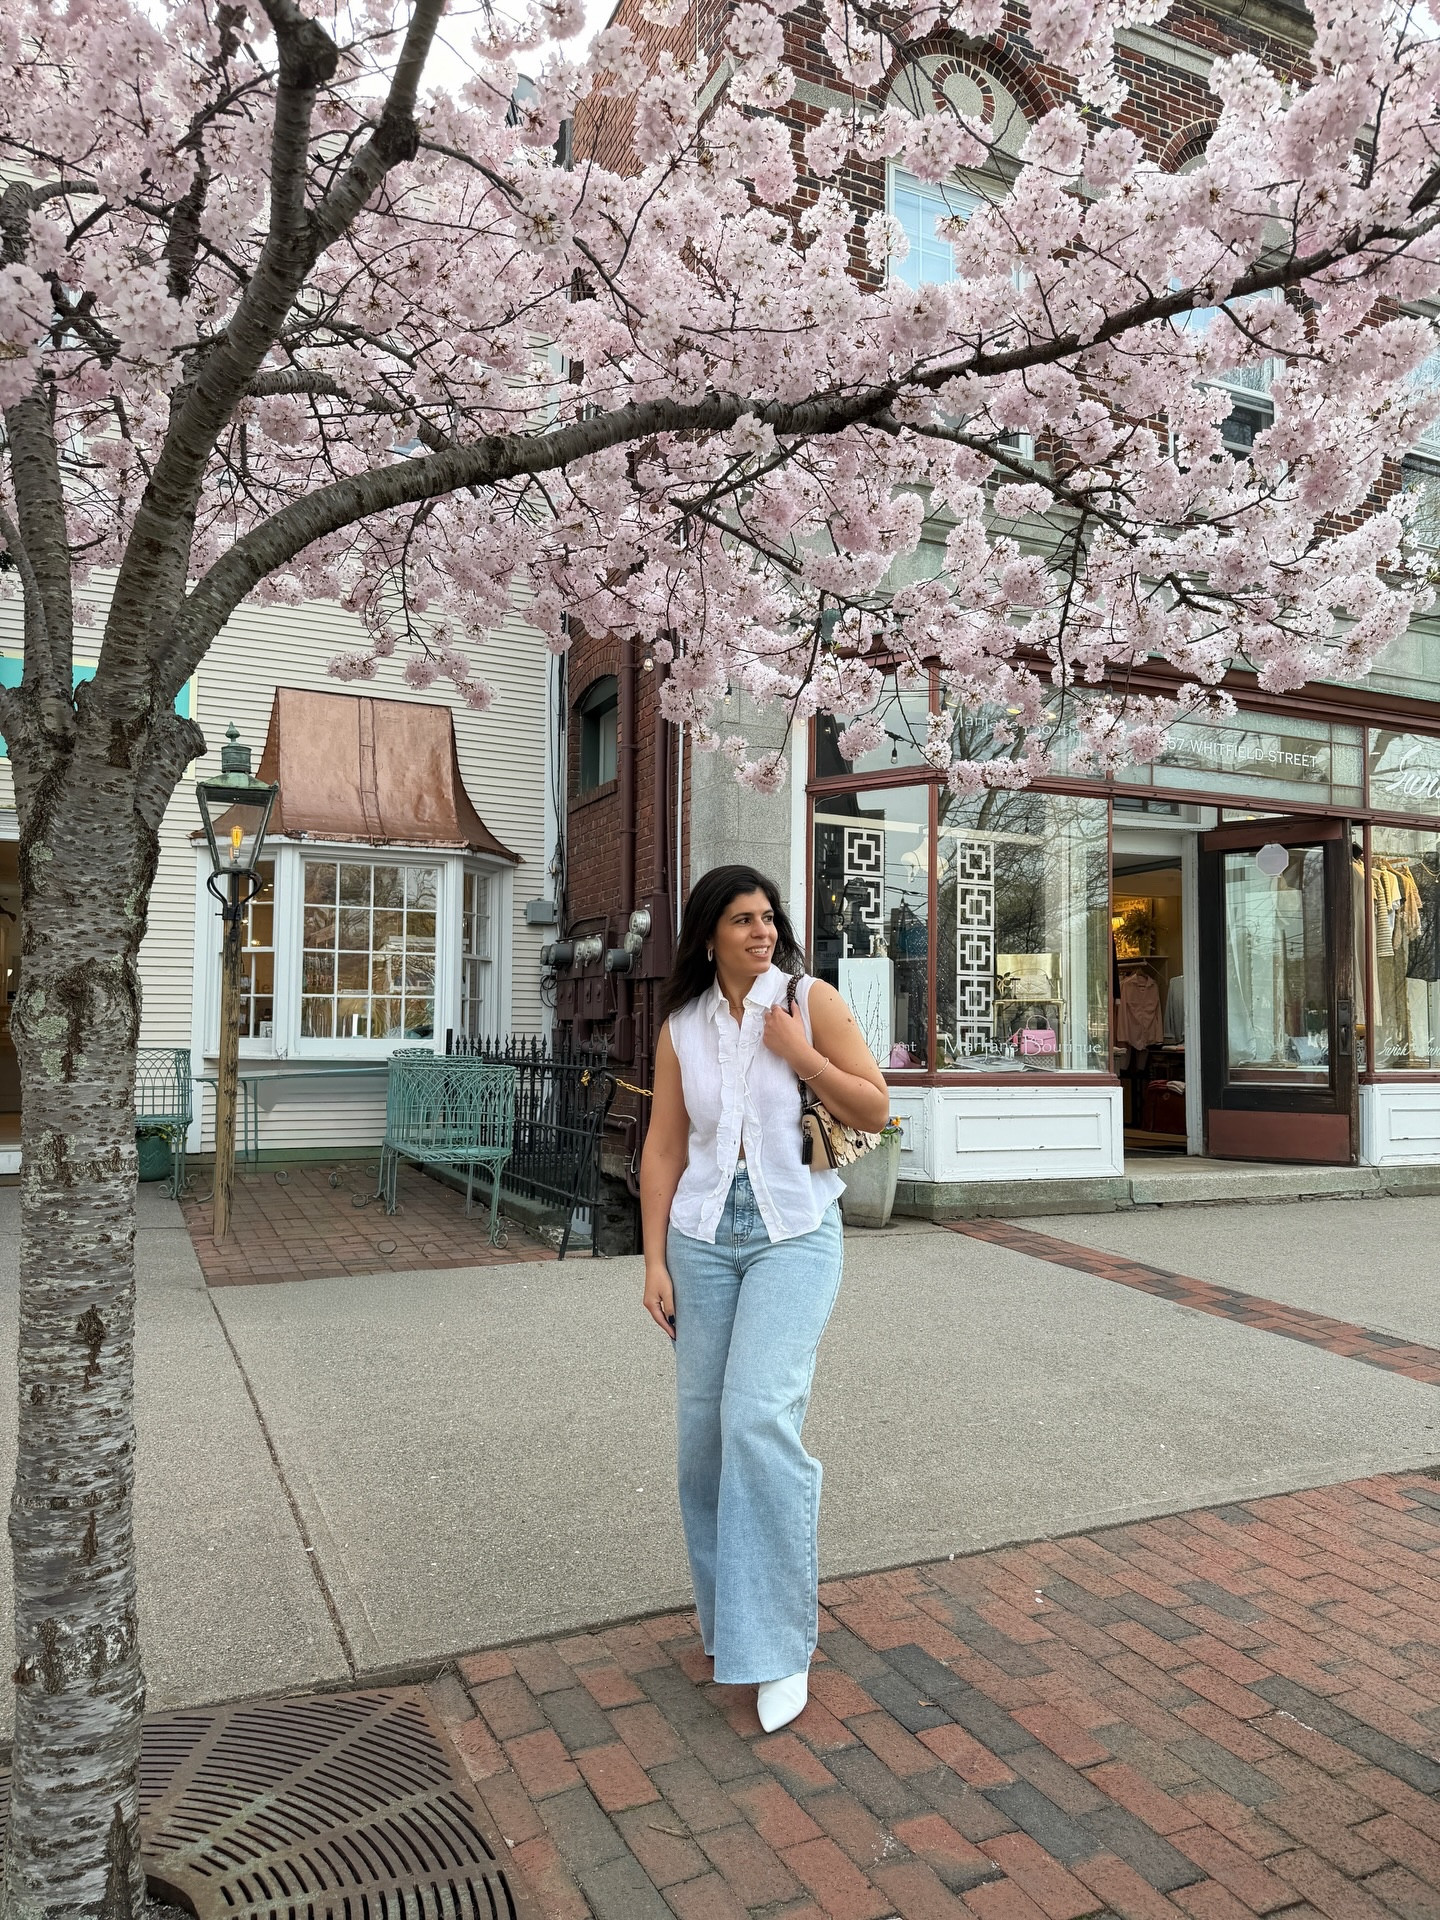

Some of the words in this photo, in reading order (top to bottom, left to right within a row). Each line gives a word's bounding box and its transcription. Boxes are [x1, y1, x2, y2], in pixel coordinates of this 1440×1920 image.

[953, 707, 1018, 738] Marijae
[1167, 737, 1185, 749] 57
[1190, 739, 1264, 761] WHITFIELD
[1268, 750, 1318, 768] STREET
[944, 1033, 1019, 1063] Marijane
[1023, 1034, 1102, 1061] Boutique
